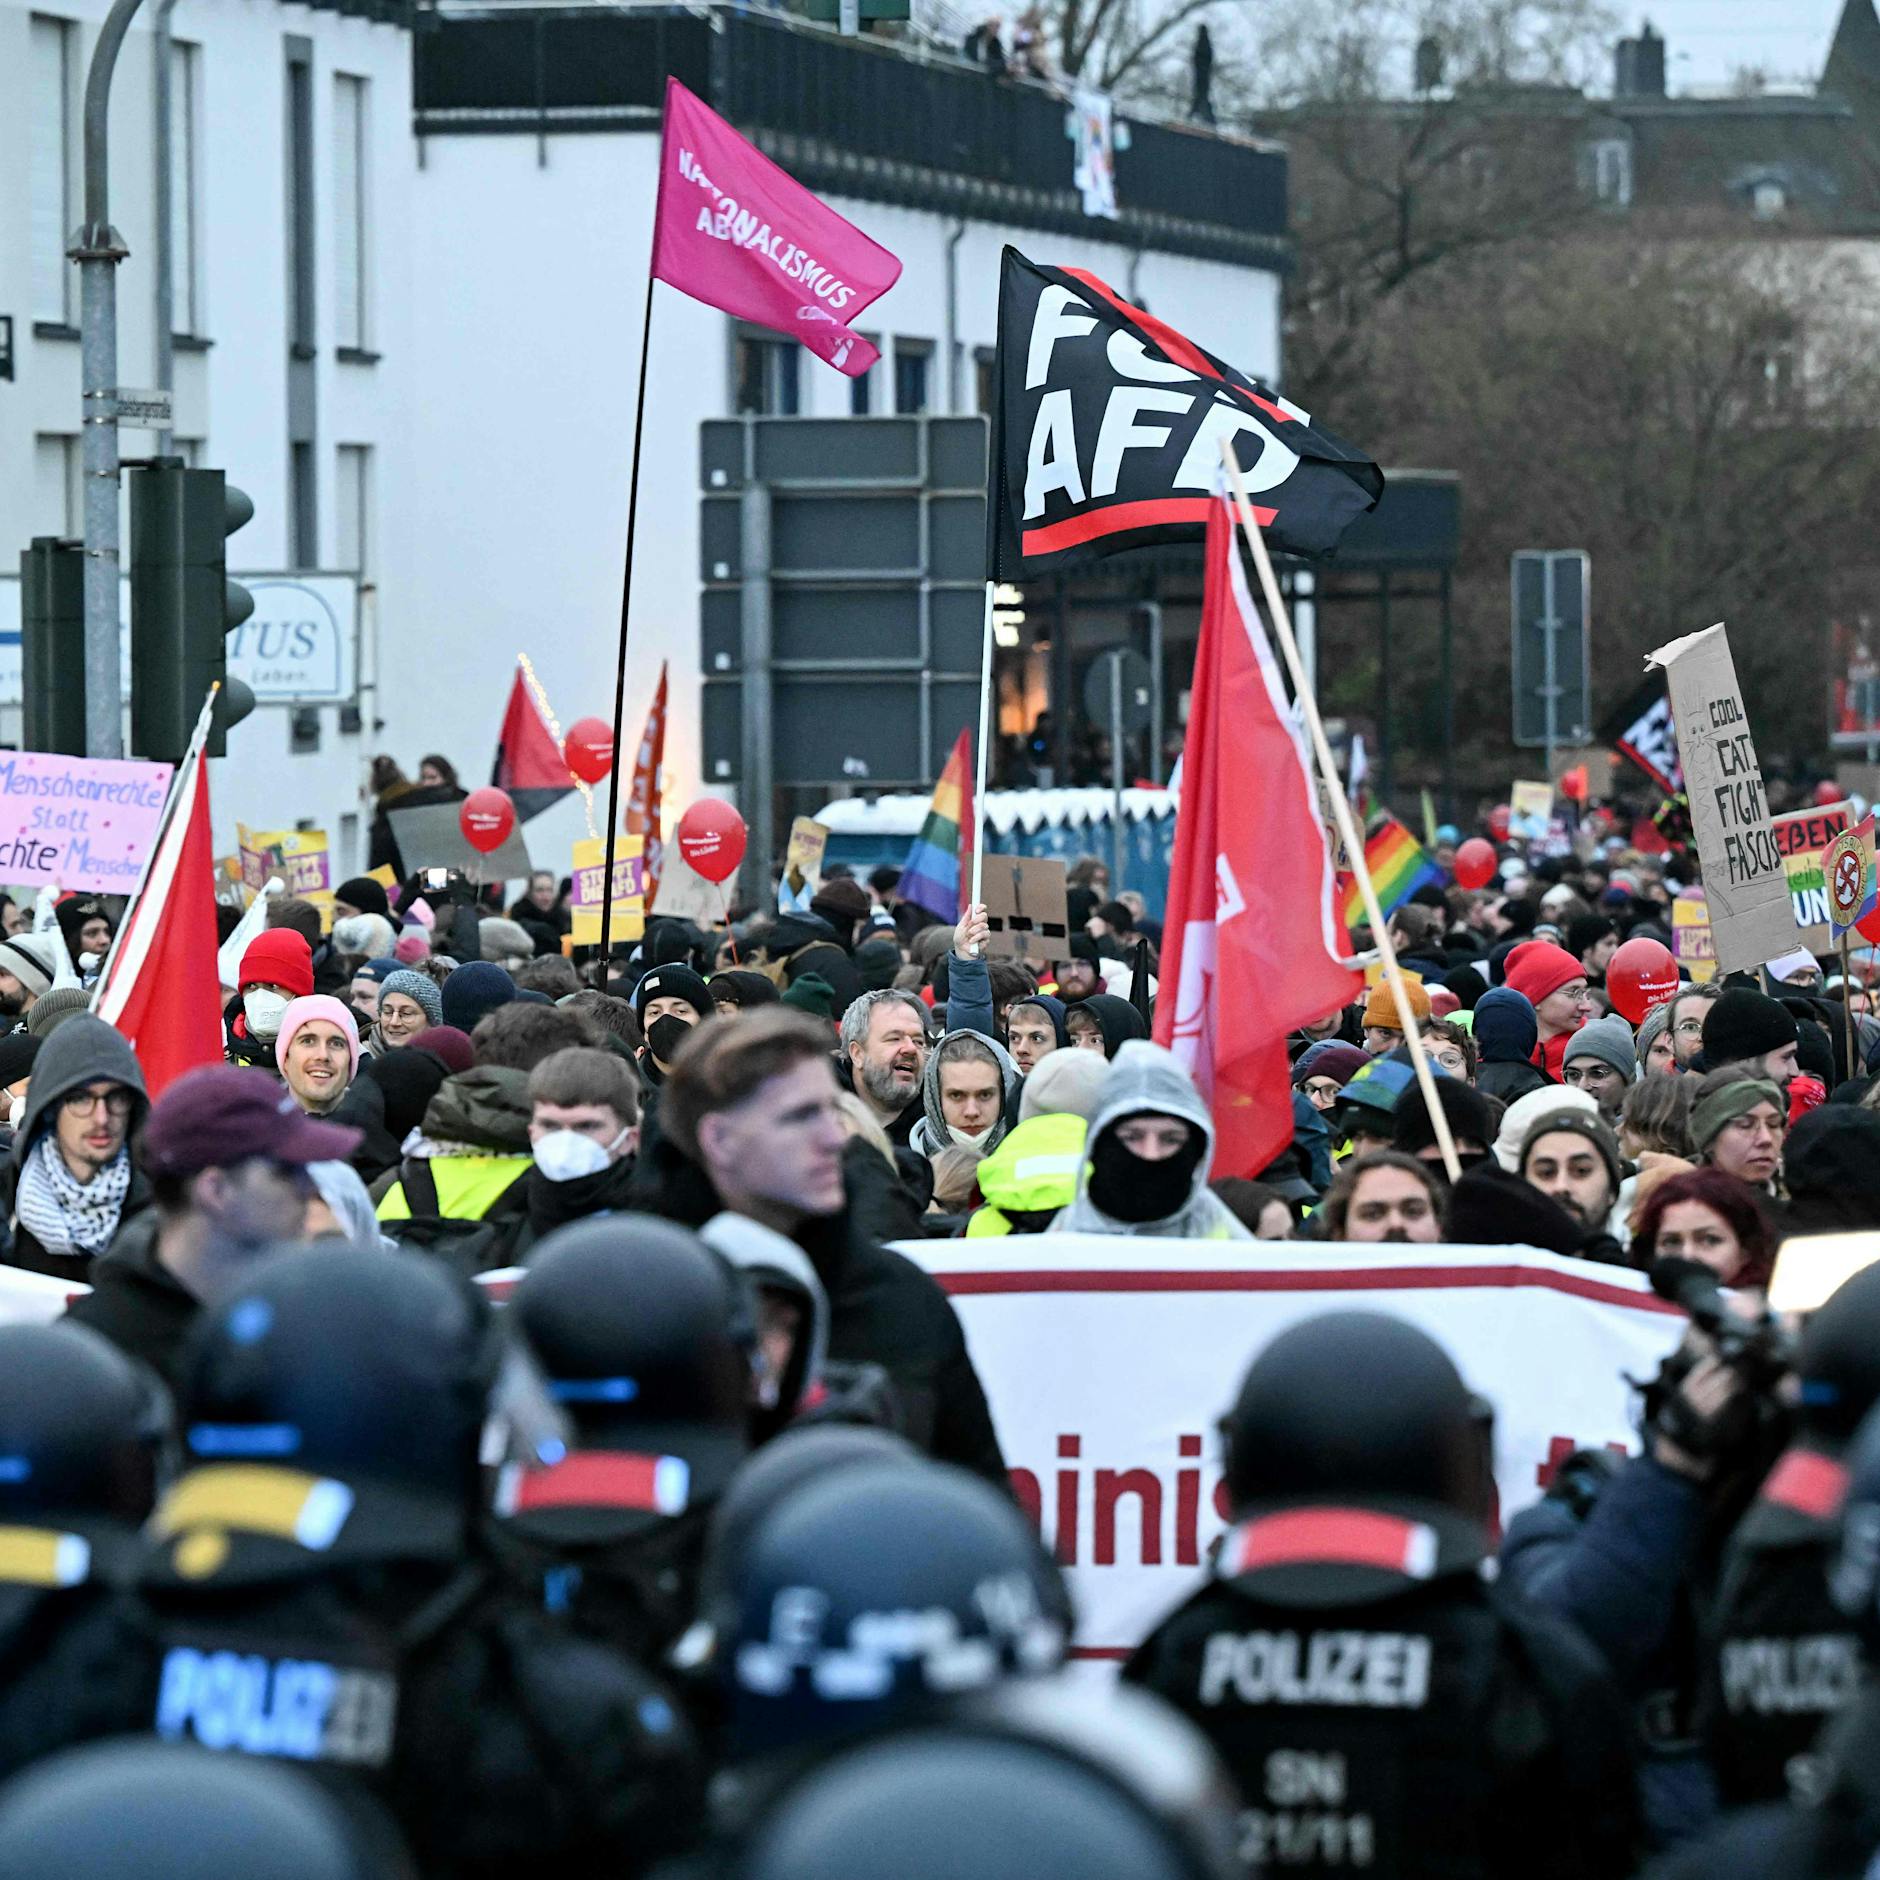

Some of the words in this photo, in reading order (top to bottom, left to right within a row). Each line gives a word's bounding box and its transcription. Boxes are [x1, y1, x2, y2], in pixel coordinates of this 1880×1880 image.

[1022, 385, 1300, 521] AFD
[231, 621, 318, 660] TUS
[1709, 696, 1743, 728] COOL
[0, 837, 58, 872] chte
[1202, 1630, 1431, 1707] POLIZEI
